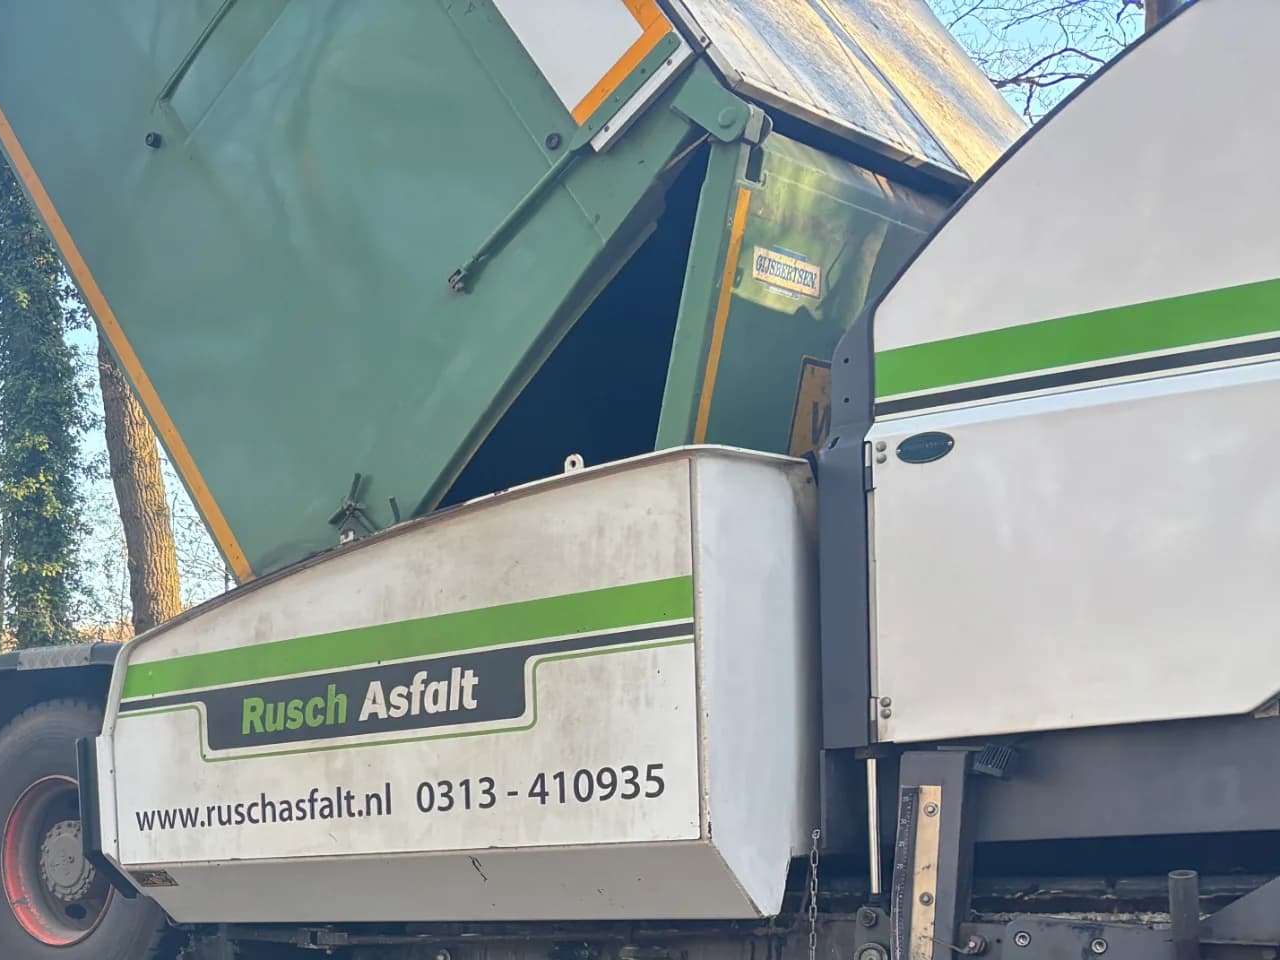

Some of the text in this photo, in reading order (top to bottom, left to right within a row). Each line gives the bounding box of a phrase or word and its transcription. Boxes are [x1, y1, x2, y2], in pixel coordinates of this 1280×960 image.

[241, 666, 480, 735] Rusch Asfalt
[135, 781, 393, 832] www.ruschasfalt.nl
[416, 776, 498, 813] 0313
[527, 763, 666, 805] 410935
